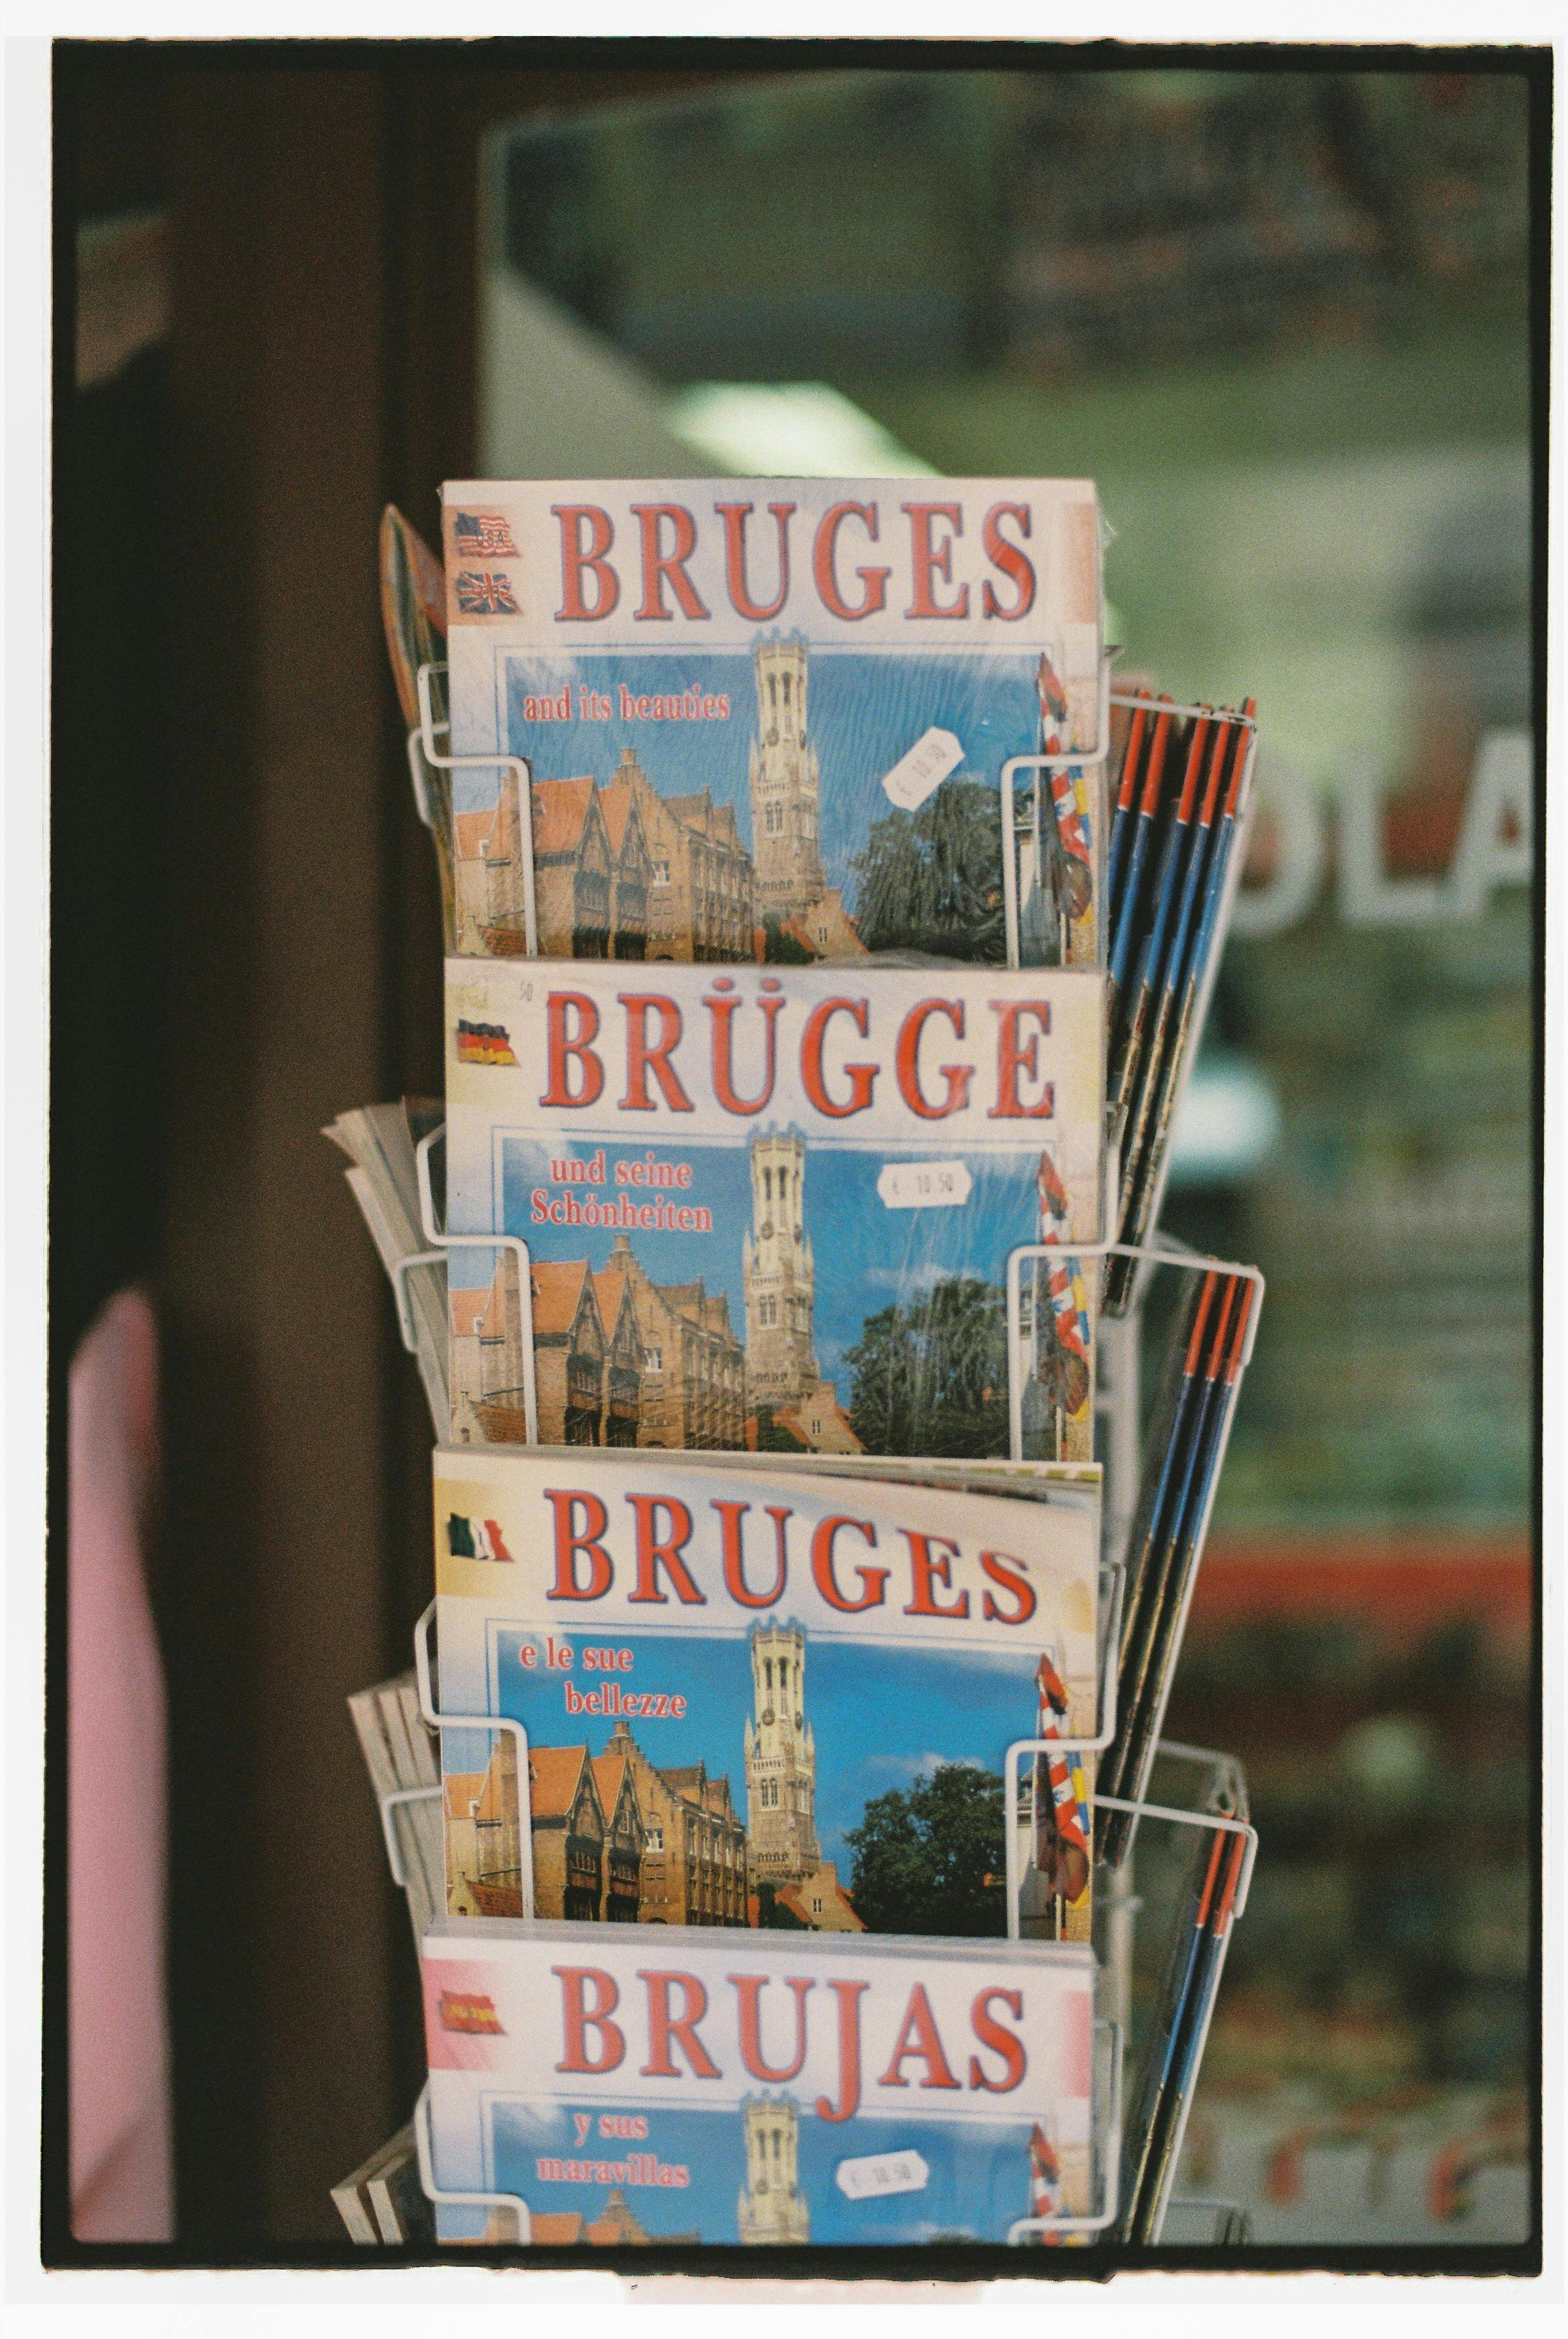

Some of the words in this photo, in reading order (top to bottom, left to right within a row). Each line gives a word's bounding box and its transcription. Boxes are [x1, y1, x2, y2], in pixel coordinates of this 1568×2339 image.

[550, 501, 1036, 623] BRUGES
[525, 684, 570, 721] and
[580, 684, 612, 721] its
[619, 683, 731, 721] beauties
[540, 977, 1055, 1119] BRÜGGE
[550, 1148, 606, 1184] und
[614, 1151, 693, 1188] seine
[531, 1188, 714, 1232] Schönheiten
[544, 1488, 1037, 1625] BRUGES
[519, 1644, 537, 1668] e
[546, 1636, 574, 1669] le
[582, 1647, 635, 1672] sue
[564, 1680, 687, 1718] bellezze
[551, 1965, 1028, 2123] BRUJAS
[573, 2113, 592, 2147] y
[599, 2114, 650, 2139] sus
[536, 2151, 691, 2187] maravillas
